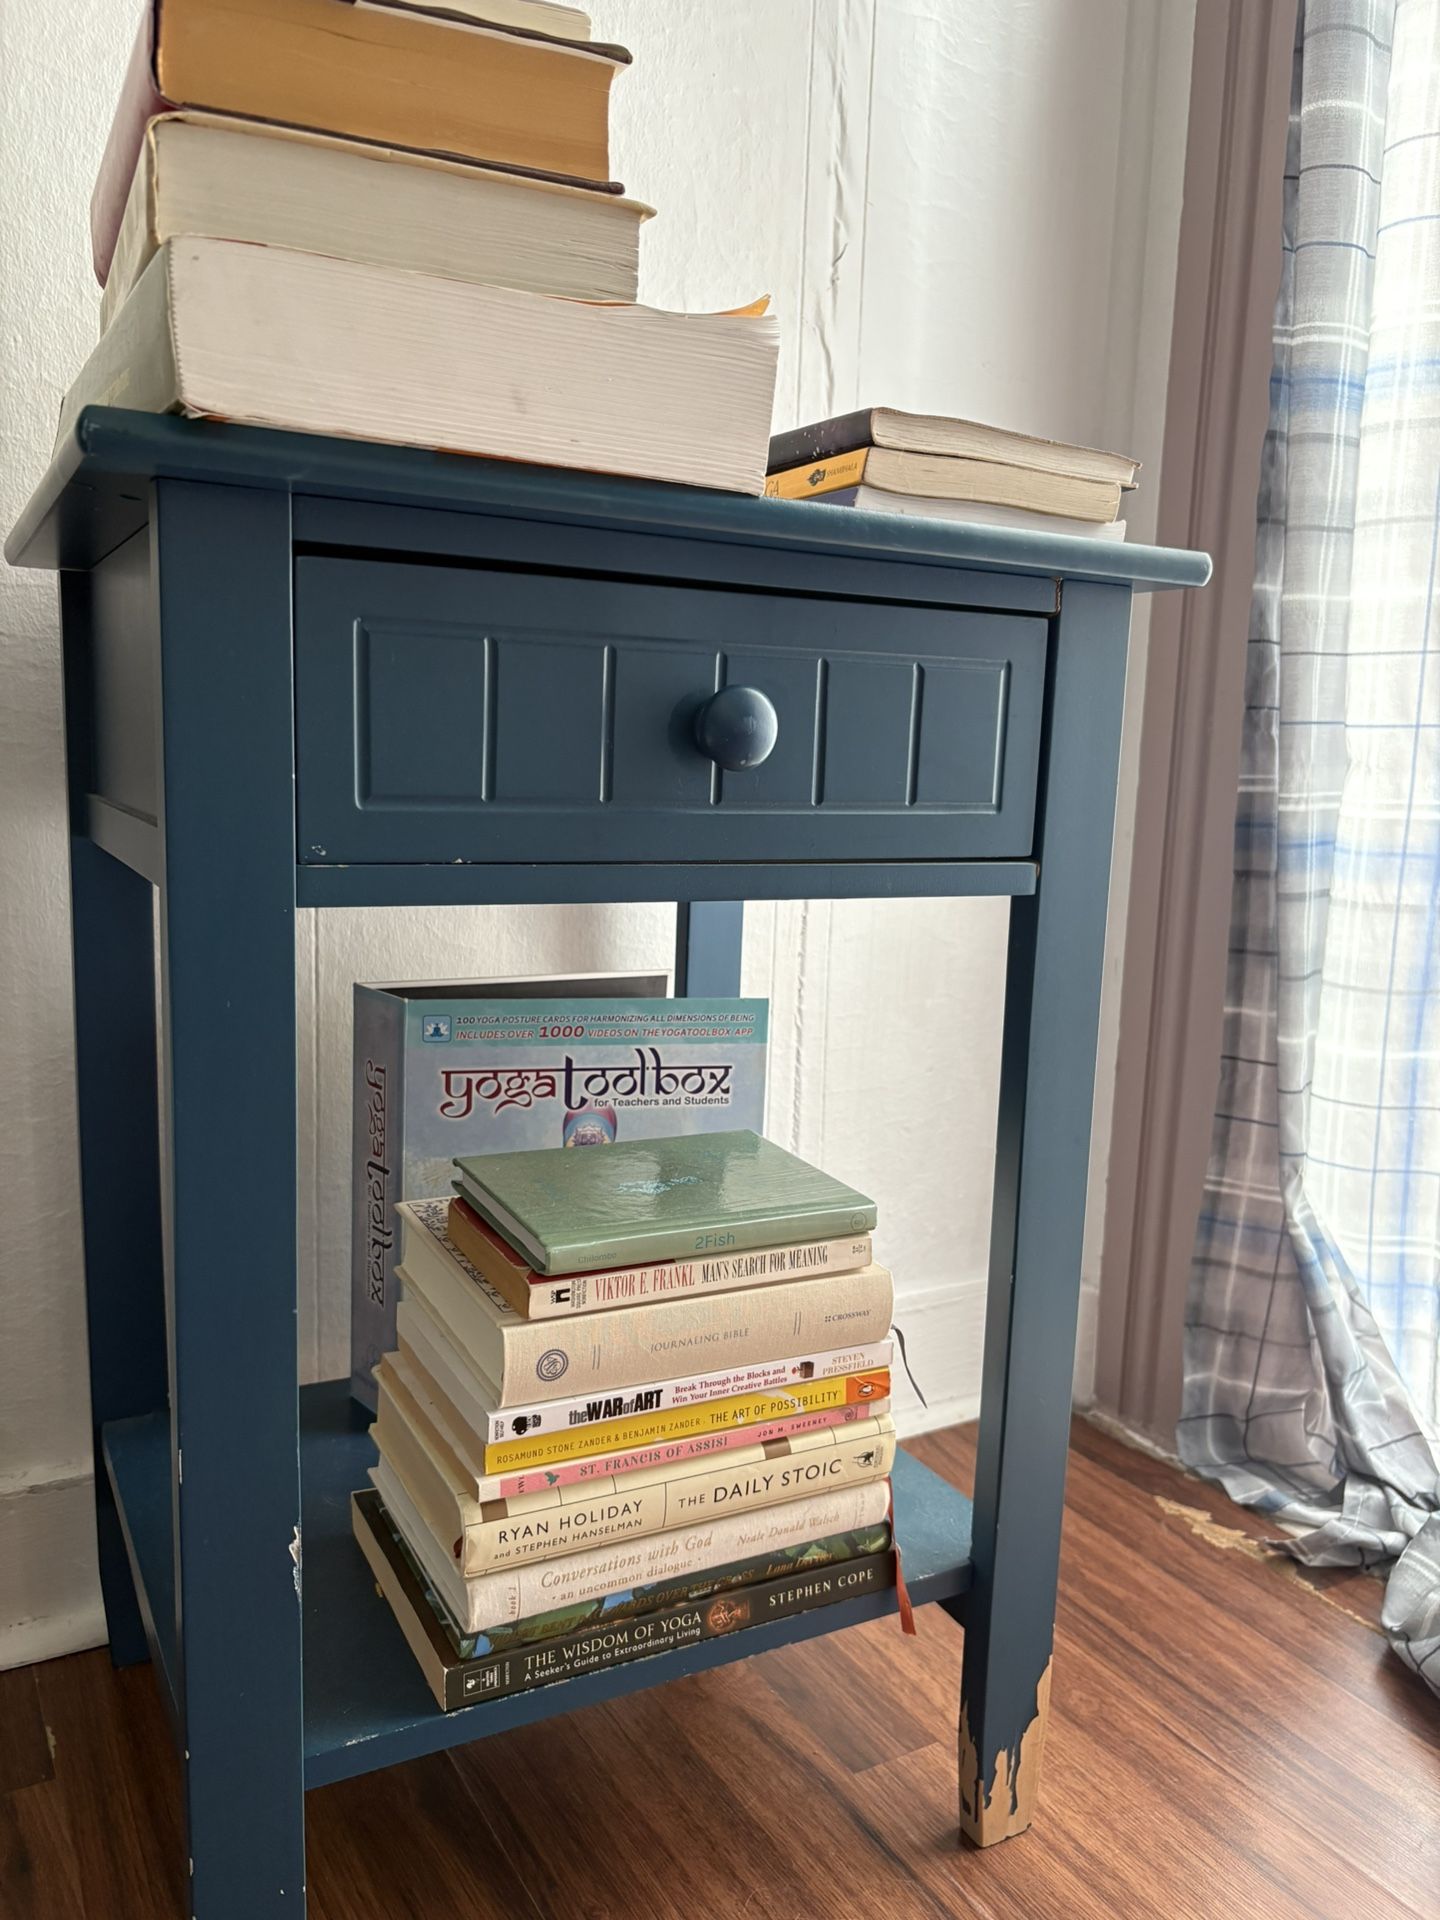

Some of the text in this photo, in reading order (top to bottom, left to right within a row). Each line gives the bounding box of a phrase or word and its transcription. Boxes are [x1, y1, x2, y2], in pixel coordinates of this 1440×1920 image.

[456, 1030, 506, 1040] INCLUDES
[508, 1030, 534, 1038] OVER
[539, 1026, 584, 1038] 1000
[588, 1029, 622, 1037] VIDEOS
[642, 1028, 660, 1036] THE
[662, 1028, 730, 1037] YOGATOOLBOX
[734, 1028, 752, 1036] APP
[477, 1016, 500, 1024] YOGA
[502, 1016, 541, 1024] POSTURE
[543, 1015, 570, 1023] CARDS
[590, 1014, 648, 1023] HARMONIZING
[650, 1014, 665, 1022] ALL
[667, 1014, 717, 1022] DIMENSIONS
[718, 1014, 730, 1022] OF
[730, 1014, 754, 1022] BEING
[594, 1096, 730, 1108] for Teachers and Students
[696, 1232, 736, 1250] 2Fish
[595, 1274, 636, 1302] VIKTOR
[640, 1272, 649, 1294] E.
[653, 1264, 695, 1292] FRANKL
[701, 1261, 730, 1284] MAN'S
[732, 1254, 766, 1280] SEARCH
[769, 1251, 786, 1272] FOR
[788, 1245, 828, 1270] MEANING
[832, 1310, 871, 1322] CROSSWAY
[650, 1328, 750, 1352] JOURNALING BIBLE
[822, 1359, 874, 1375] PRESSFIELD
[832, 1352, 866, 1364] STEVEN
[672, 1376, 788, 1404] Win Your Inner Creative Battles
[674, 1366, 786, 1394] Break Through the Blocks and
[710, 1390, 838, 1424] THE ART OF POSSIBILITY
[496, 1418, 701, 1464] ROSAMUND STONE ZANDER & BENJAMIN ZANDER
[757, 1417, 828, 1438] JON M. SWEENEY
[580, 1437, 728, 1477] ST. FRANCIS OF ASSISI
[678, 1458, 843, 1509] THE DAILY STOIC
[498, 1500, 643, 1544] RYAN HOLIDAY
[768, 1520, 805, 1537] Donald
[808, 1512, 840, 1528] Walsch
[494, 1518, 642, 1560] and STEPHEN HANSELMAN
[541, 1532, 714, 1588] Conversations with God
[560, 1560, 693, 1601] an uncommon dialogue
[769, 1568, 874, 1607] STEPHEN COPE
[656, 1587, 688, 1603] OVER
[524, 1611, 702, 1670] THE WISDOM OF YOGA
[524, 1673, 532, 1682] A
[535, 1662, 570, 1680] Seeker's
[574, 1655, 600, 1668] Guide
[602, 1652, 612, 1660] to
[614, 1636, 674, 1658] Extraordinary
[676, 1626, 700, 1642] Living
